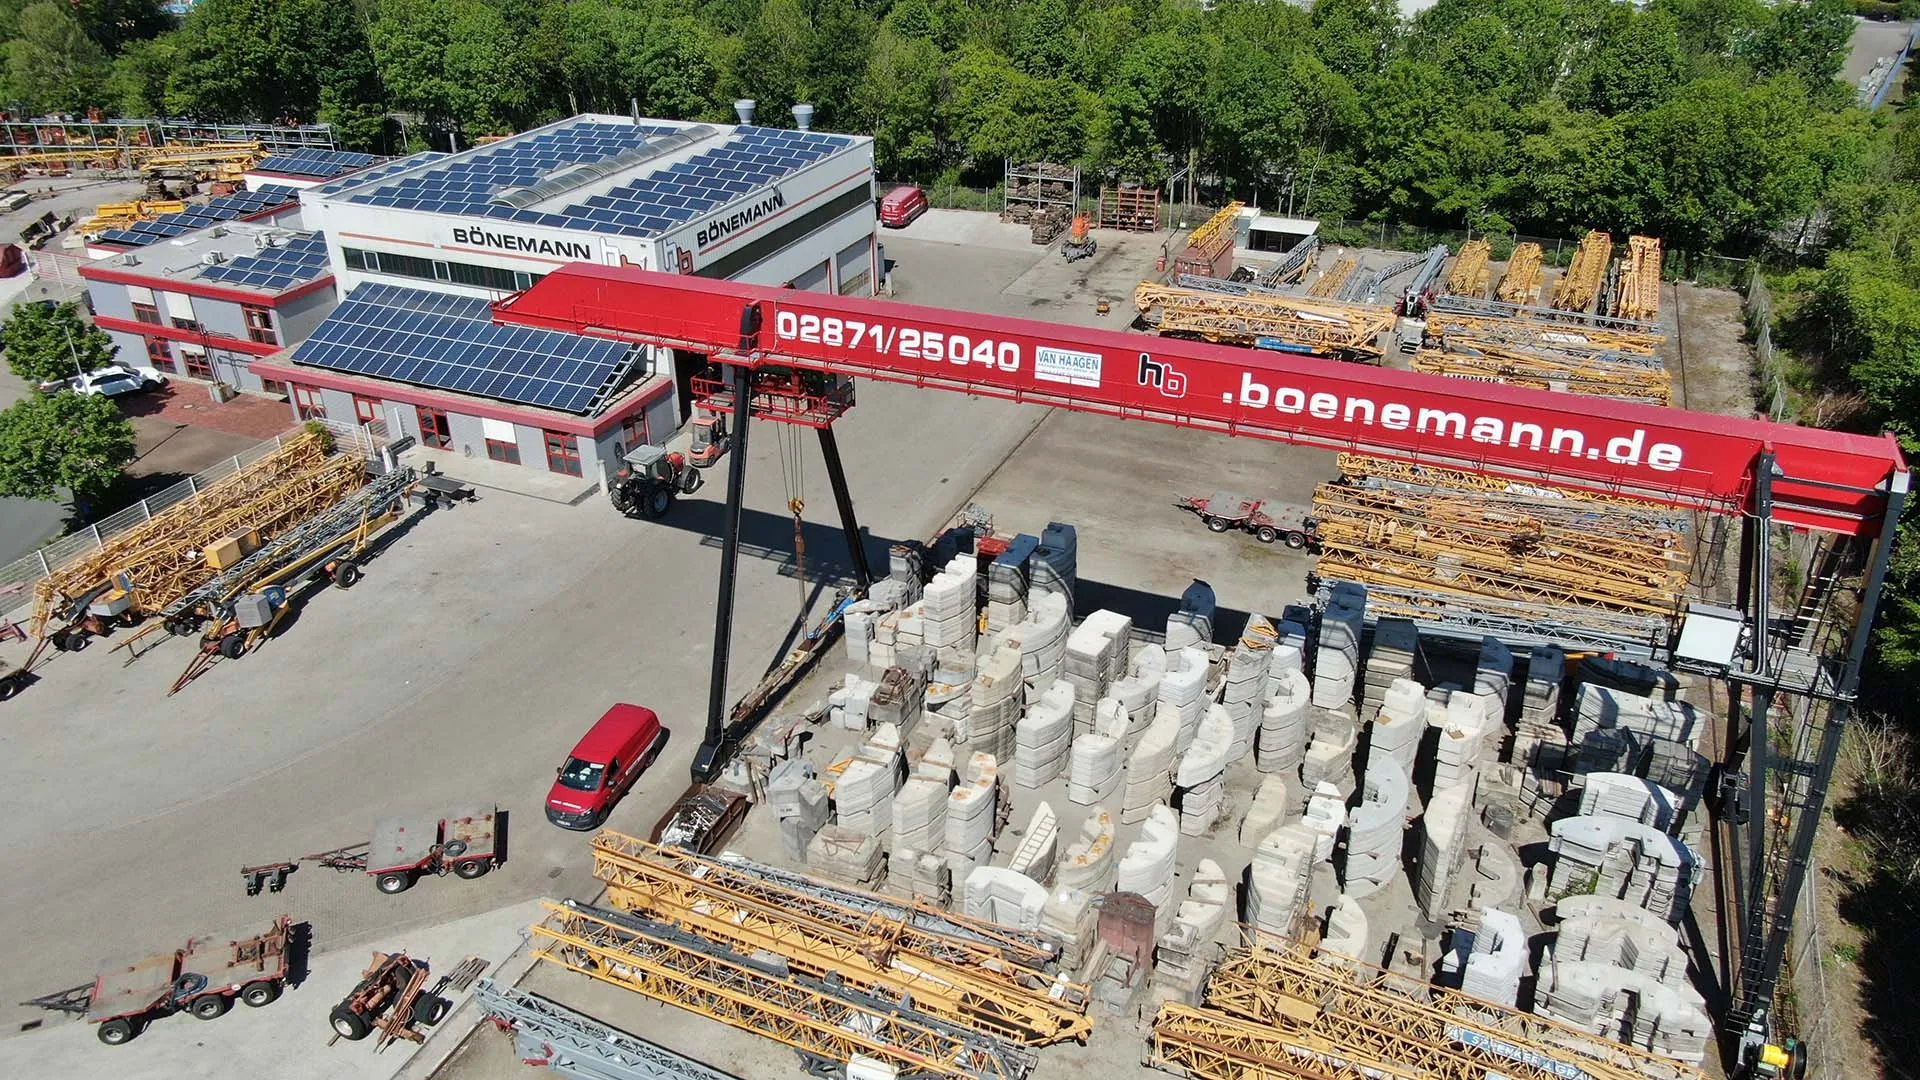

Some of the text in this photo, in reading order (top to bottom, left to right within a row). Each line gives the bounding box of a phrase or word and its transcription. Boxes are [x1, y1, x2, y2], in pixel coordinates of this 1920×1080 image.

[453, 226, 591, 259] BÖNEMANN
[697, 193, 783, 248] BÖNEMANN
[777, 311, 1021, 372] 02871/25040
[1038, 351, 1057, 364] VAN
[1059, 355, 1099, 370] HAAGEN
[1138, 353, 1684, 472] hb .boenemann.de
